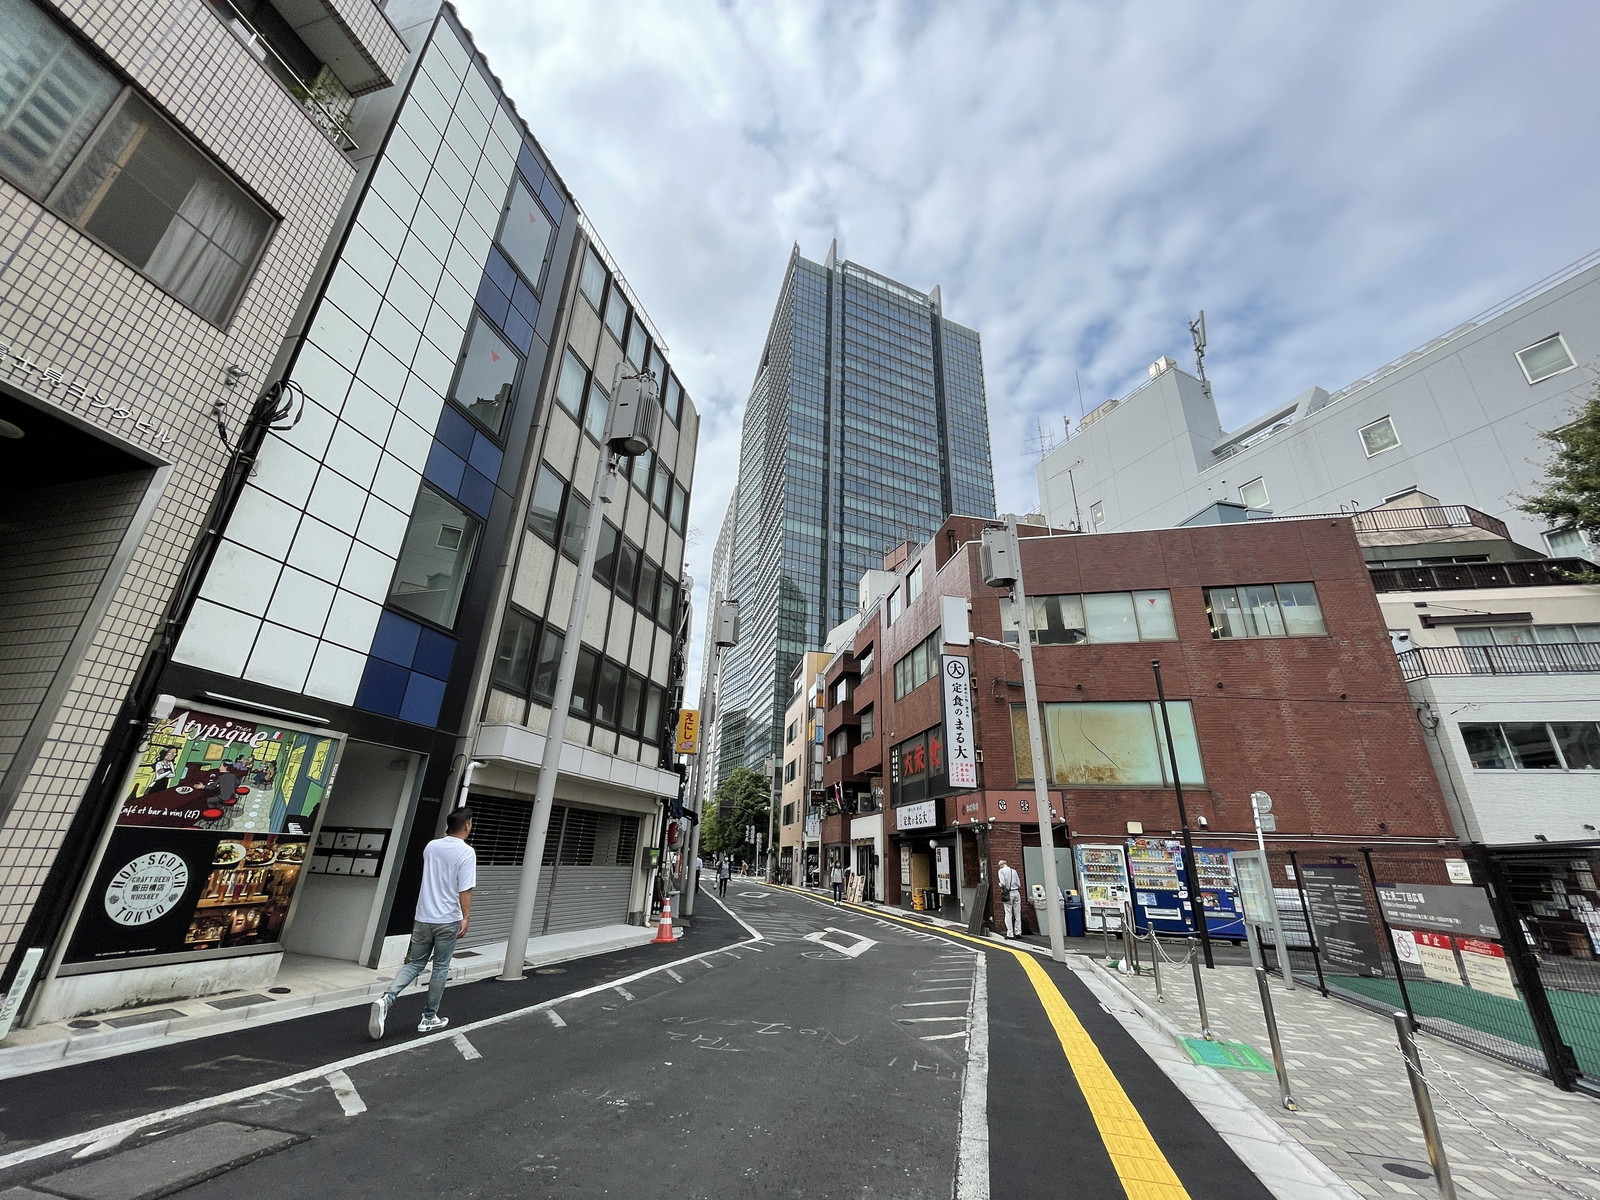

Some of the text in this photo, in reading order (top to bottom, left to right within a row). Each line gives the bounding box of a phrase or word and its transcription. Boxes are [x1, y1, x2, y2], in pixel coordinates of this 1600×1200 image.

[154, 711, 268, 748] Atypique
[683, 712, 694, 740] えにし
[951, 683, 969, 760] 定食のまる大
[138, 806, 147, 814] et
[148, 806, 162, 815] bar
[131, 893, 160, 901] WHISKEY
[115, 904, 165, 923] TOKYO
[1422, 934, 1441, 947] 禁止
